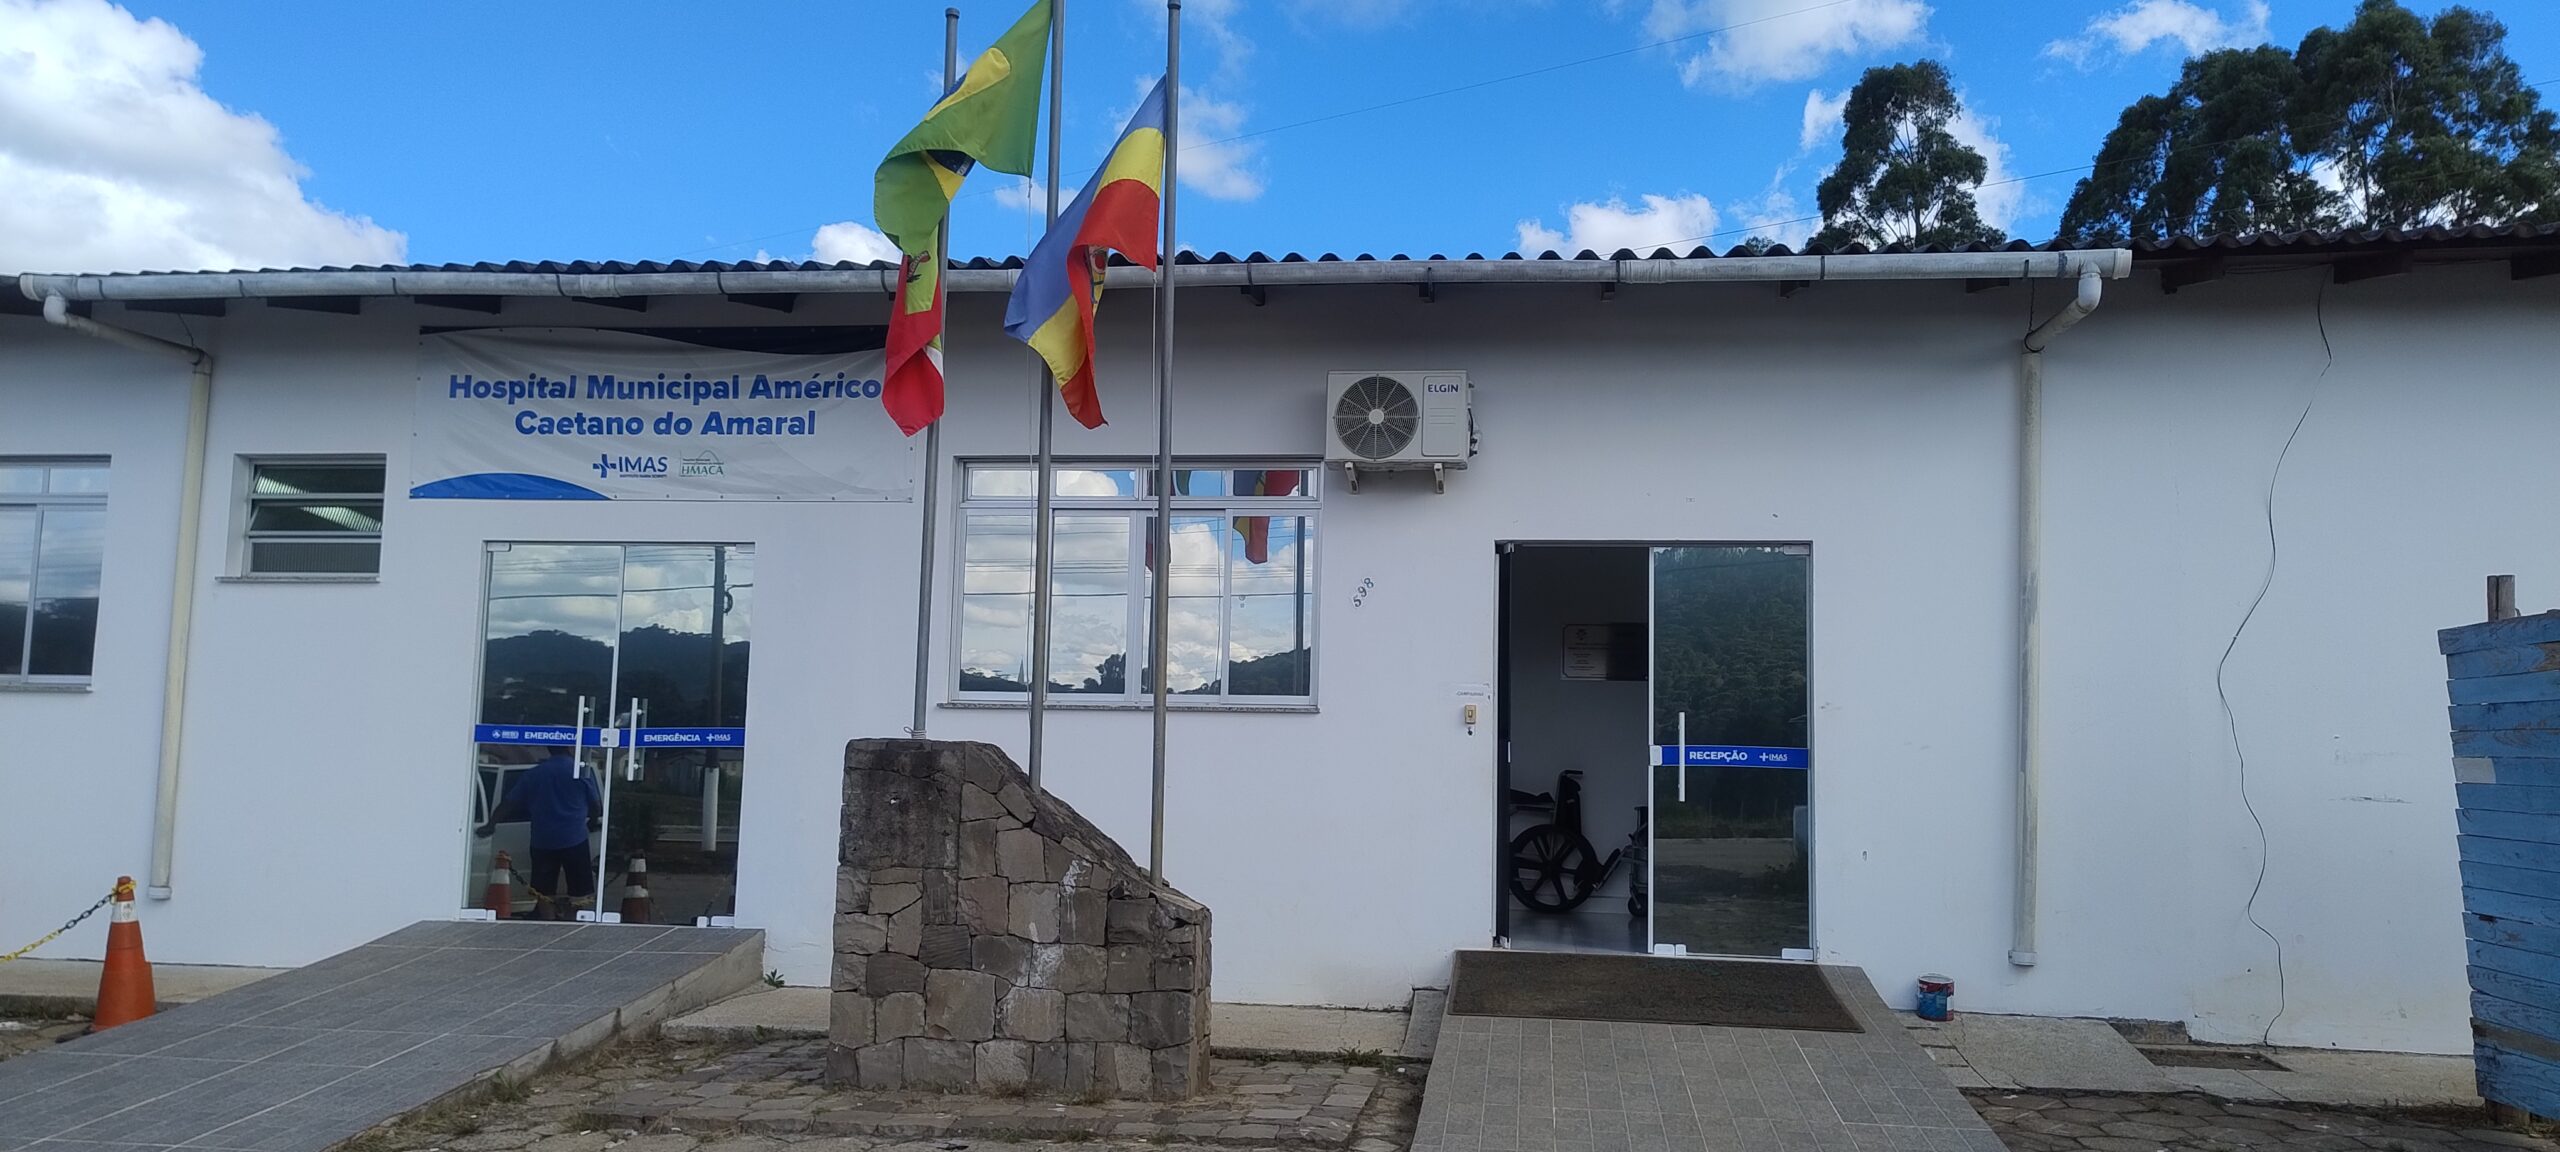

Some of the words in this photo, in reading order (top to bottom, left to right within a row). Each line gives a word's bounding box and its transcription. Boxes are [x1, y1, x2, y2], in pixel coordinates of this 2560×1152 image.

[449, 373, 577, 405] Hospital
[586, 373, 739, 405] Municipal
[748, 372, 882, 400] Américo
[1427, 384, 1459, 393] ELGIN
[515, 410, 645, 435] Caetano
[653, 411, 693, 435] do
[700, 410, 816, 435] Amaral
[618, 456, 668, 473] IMAS
[681, 465, 725, 475] HMACA
[1353, 577, 1374, 608] 598
[644, 732, 701, 742] EMERGÊNCIA
[1689, 750, 1748, 763] RECEPÇÃO
